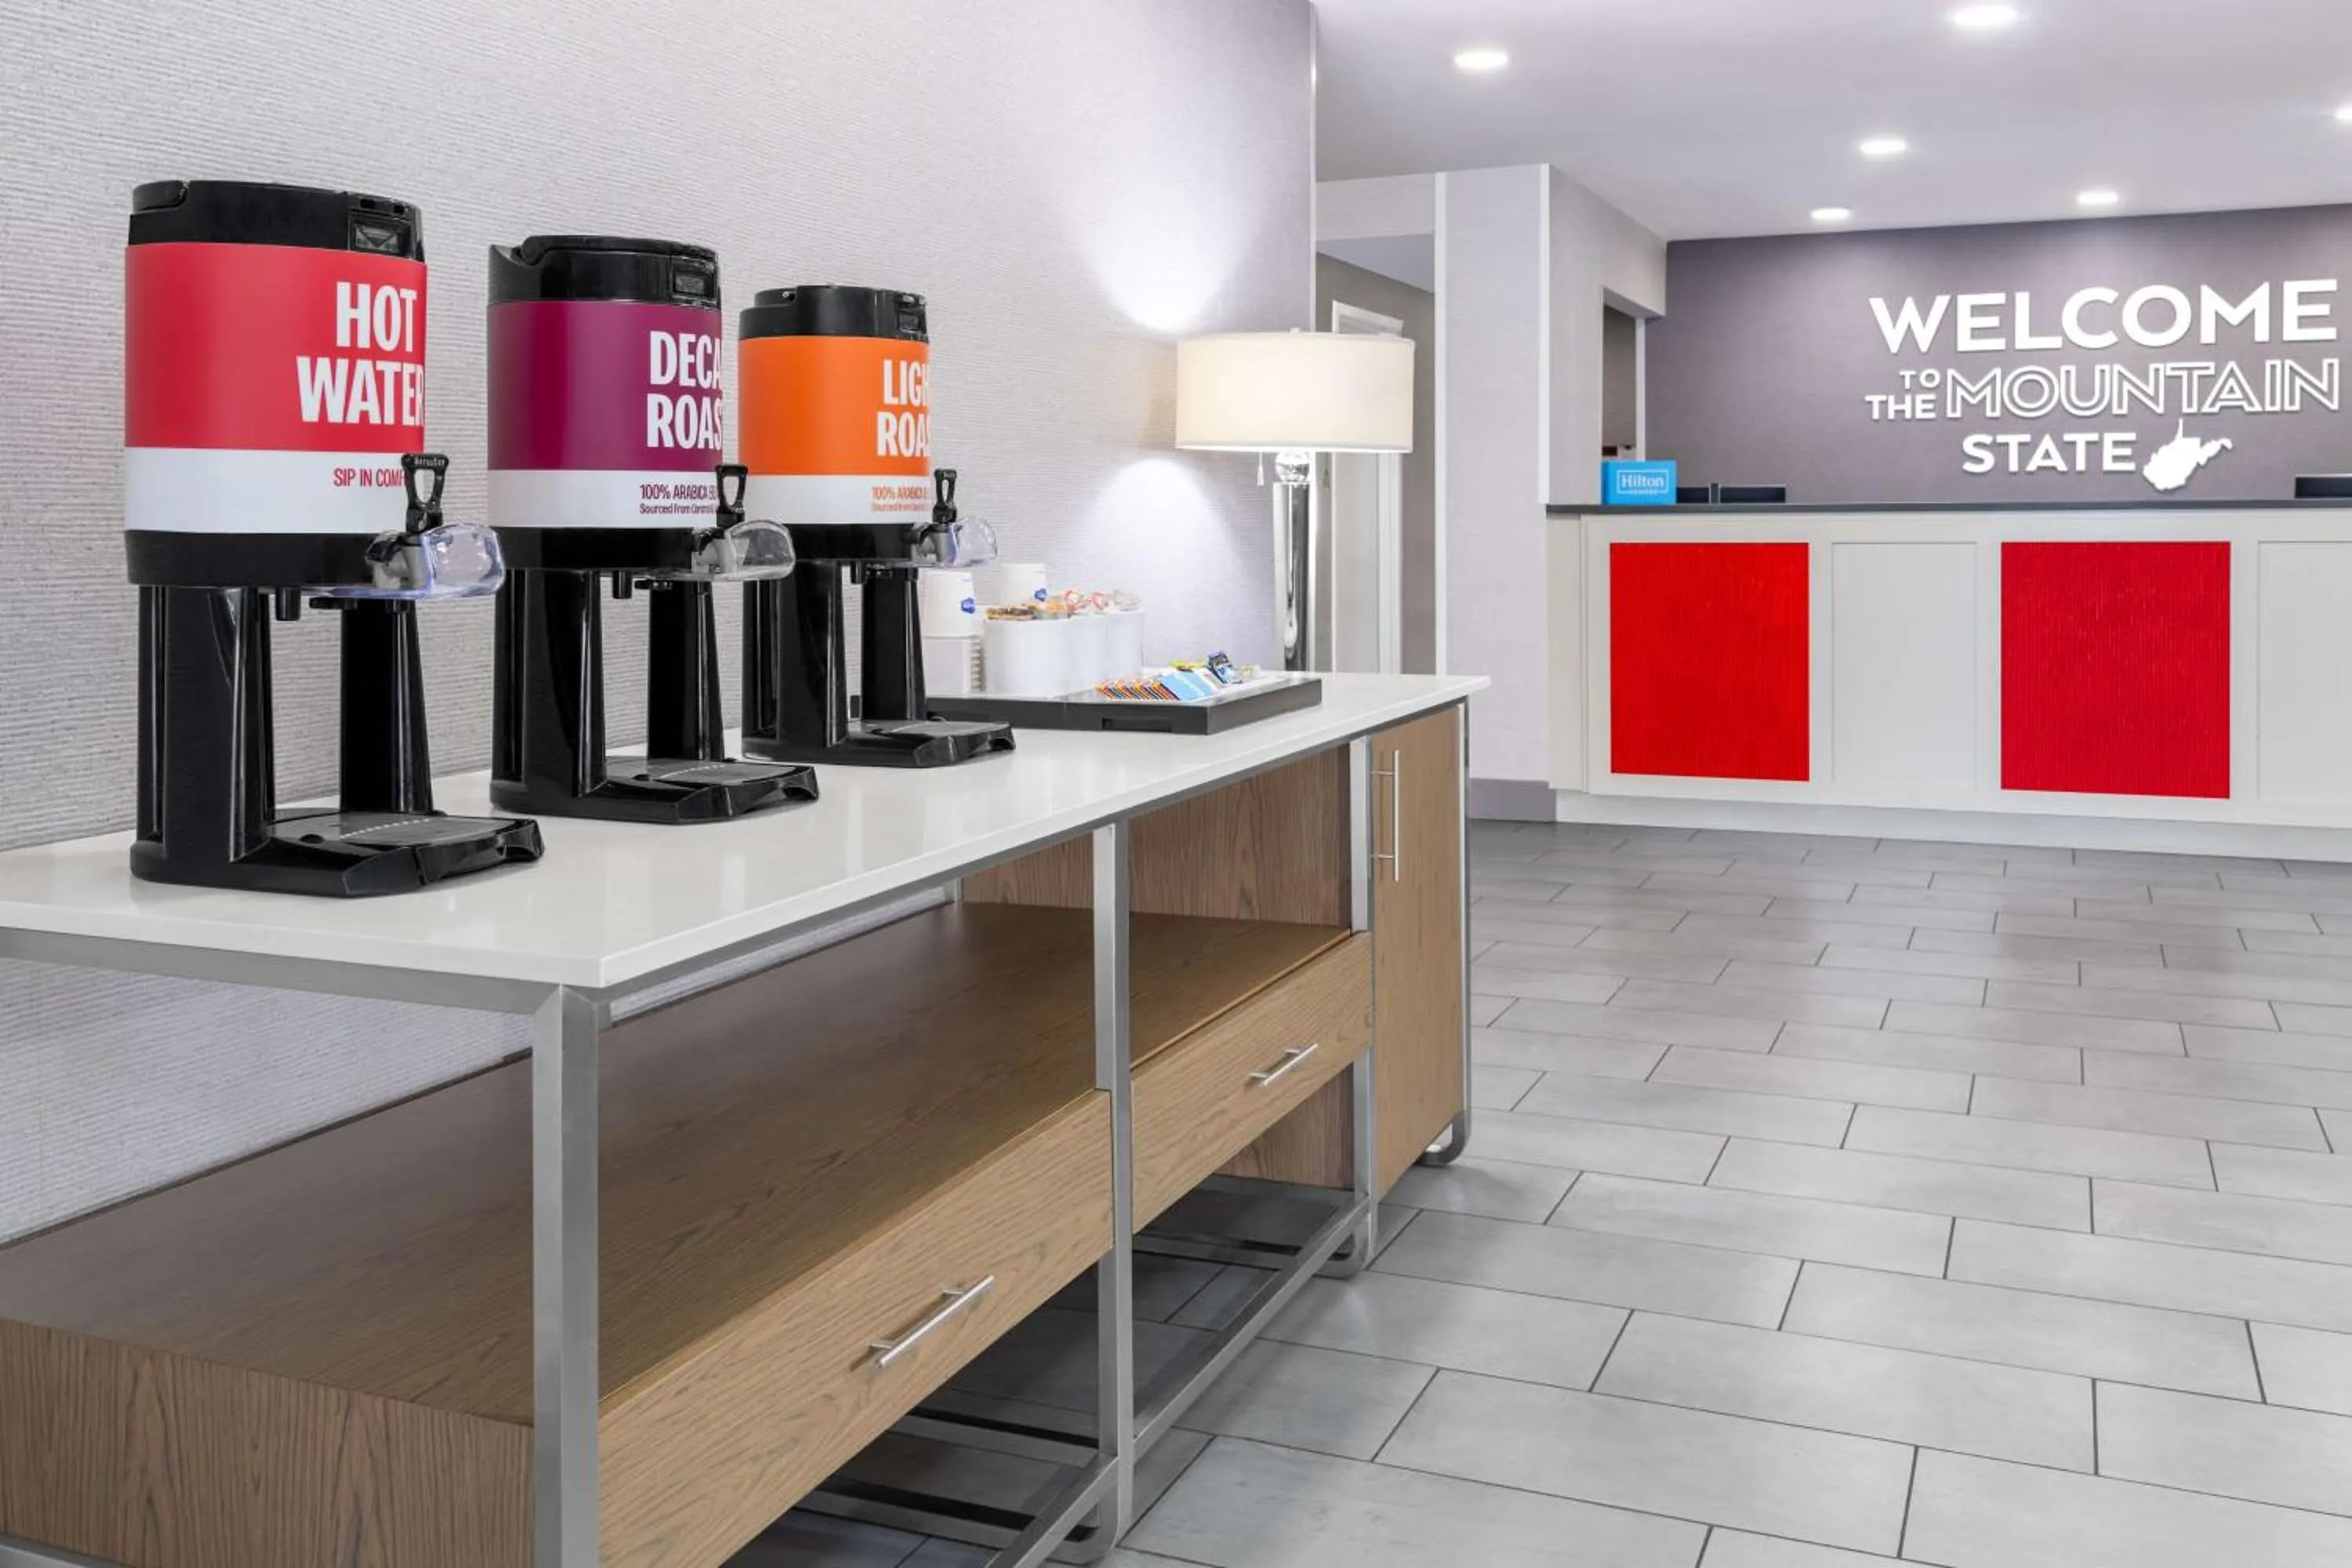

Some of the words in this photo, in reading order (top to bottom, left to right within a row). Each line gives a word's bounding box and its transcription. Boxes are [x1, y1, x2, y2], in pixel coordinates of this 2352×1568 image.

[336, 281, 418, 353] HOT
[1869, 279, 2338, 354] WELCOME
[650, 330, 722, 390] DECA
[884, 359, 930, 408] LIGH
[1900, 368, 1940, 390] TO
[296, 355, 425, 427] WATER
[1864, 394, 1937, 420] THE
[1946, 358, 2340, 419] MOUNTAIN
[647, 393, 723, 451] ROAS
[333, 467, 356, 487] SIP
[360, 468, 372, 487] IN
[1961, 431, 2137, 474] STATE
[639, 484, 672, 500] 100%
[1621, 473, 1664, 488] Hilton
